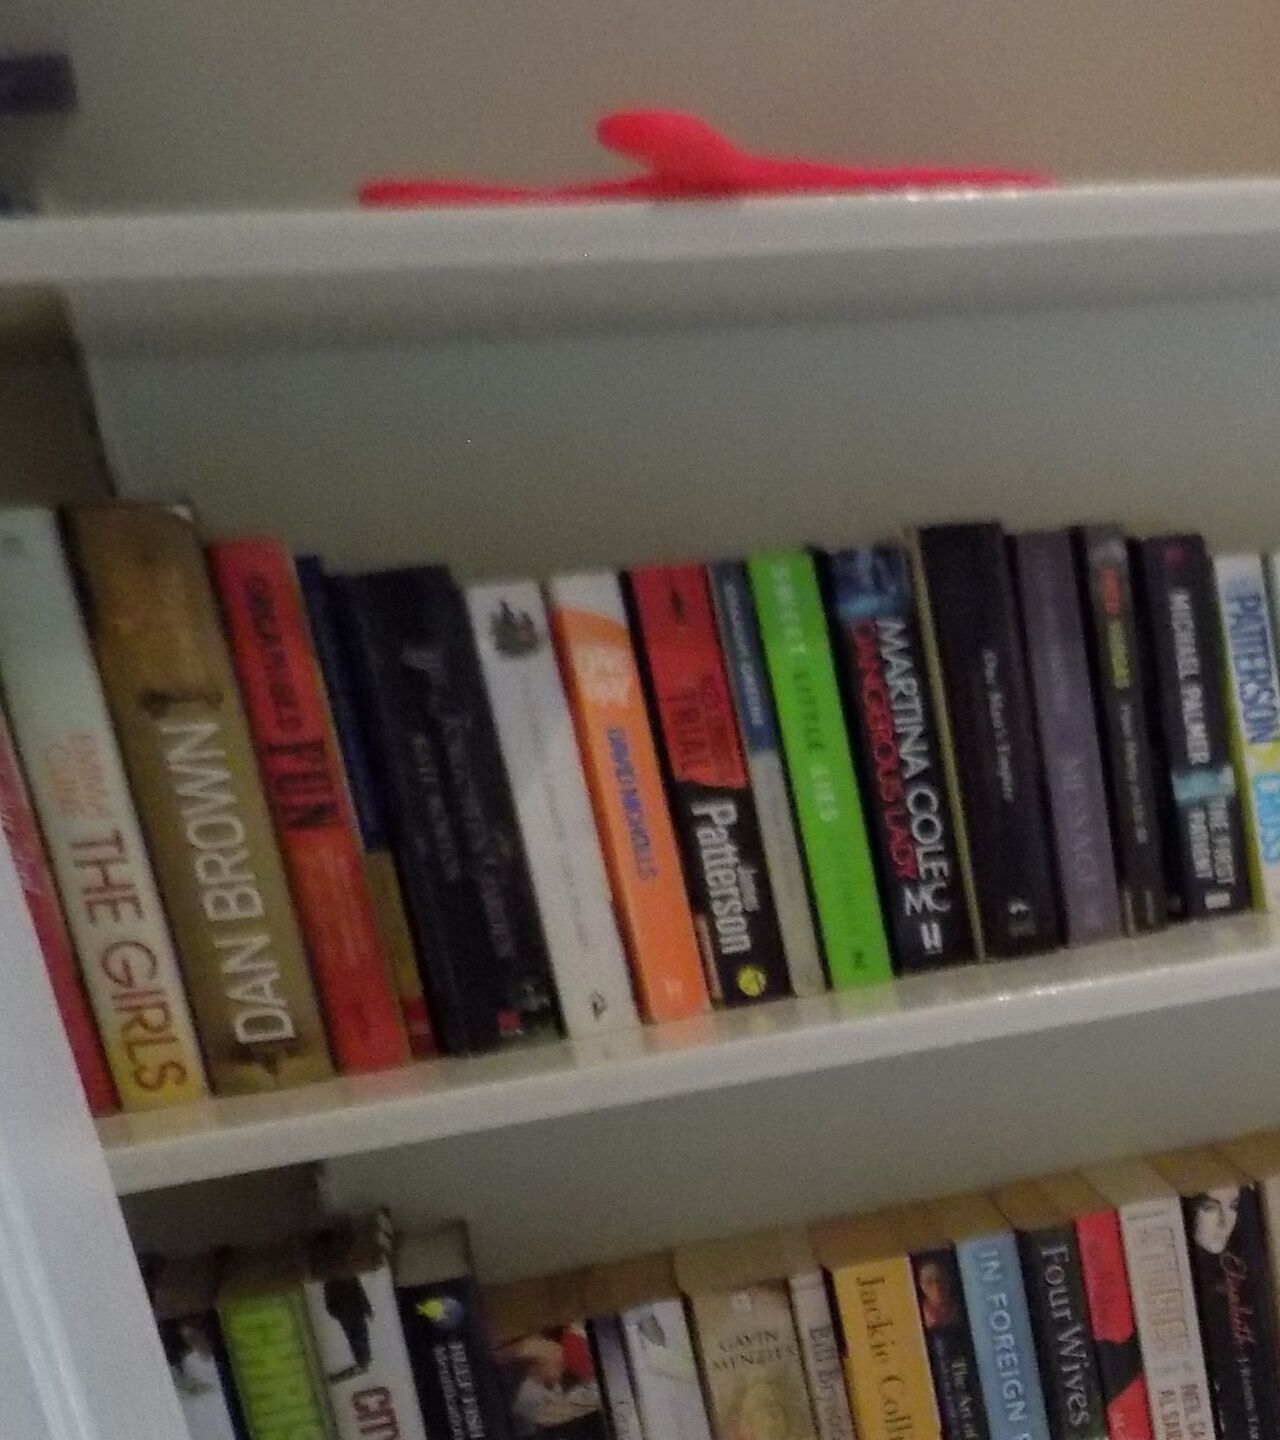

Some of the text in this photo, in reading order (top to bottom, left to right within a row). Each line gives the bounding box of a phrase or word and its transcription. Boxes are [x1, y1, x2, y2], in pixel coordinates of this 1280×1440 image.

[1168, 588, 1210, 766] MICHAEL PALMER
[876, 618, 948, 879] MARTINA COLE
[70, 831, 140, 925] THE
[166, 721, 298, 1044] DAN BROWN
[690, 799, 754, 954] Patterson
[102, 940, 187, 1093] GIRLS
[854, 1273, 896, 1365] Jackie
[977, 1249, 1002, 1282] IN
[1040, 1242, 1094, 1427] Four Wives
[809, 1324, 836, 1363] Bill
[985, 1292, 1028, 1422] FOREIGN
[1180, 1383, 1200, 1419] NEIL
